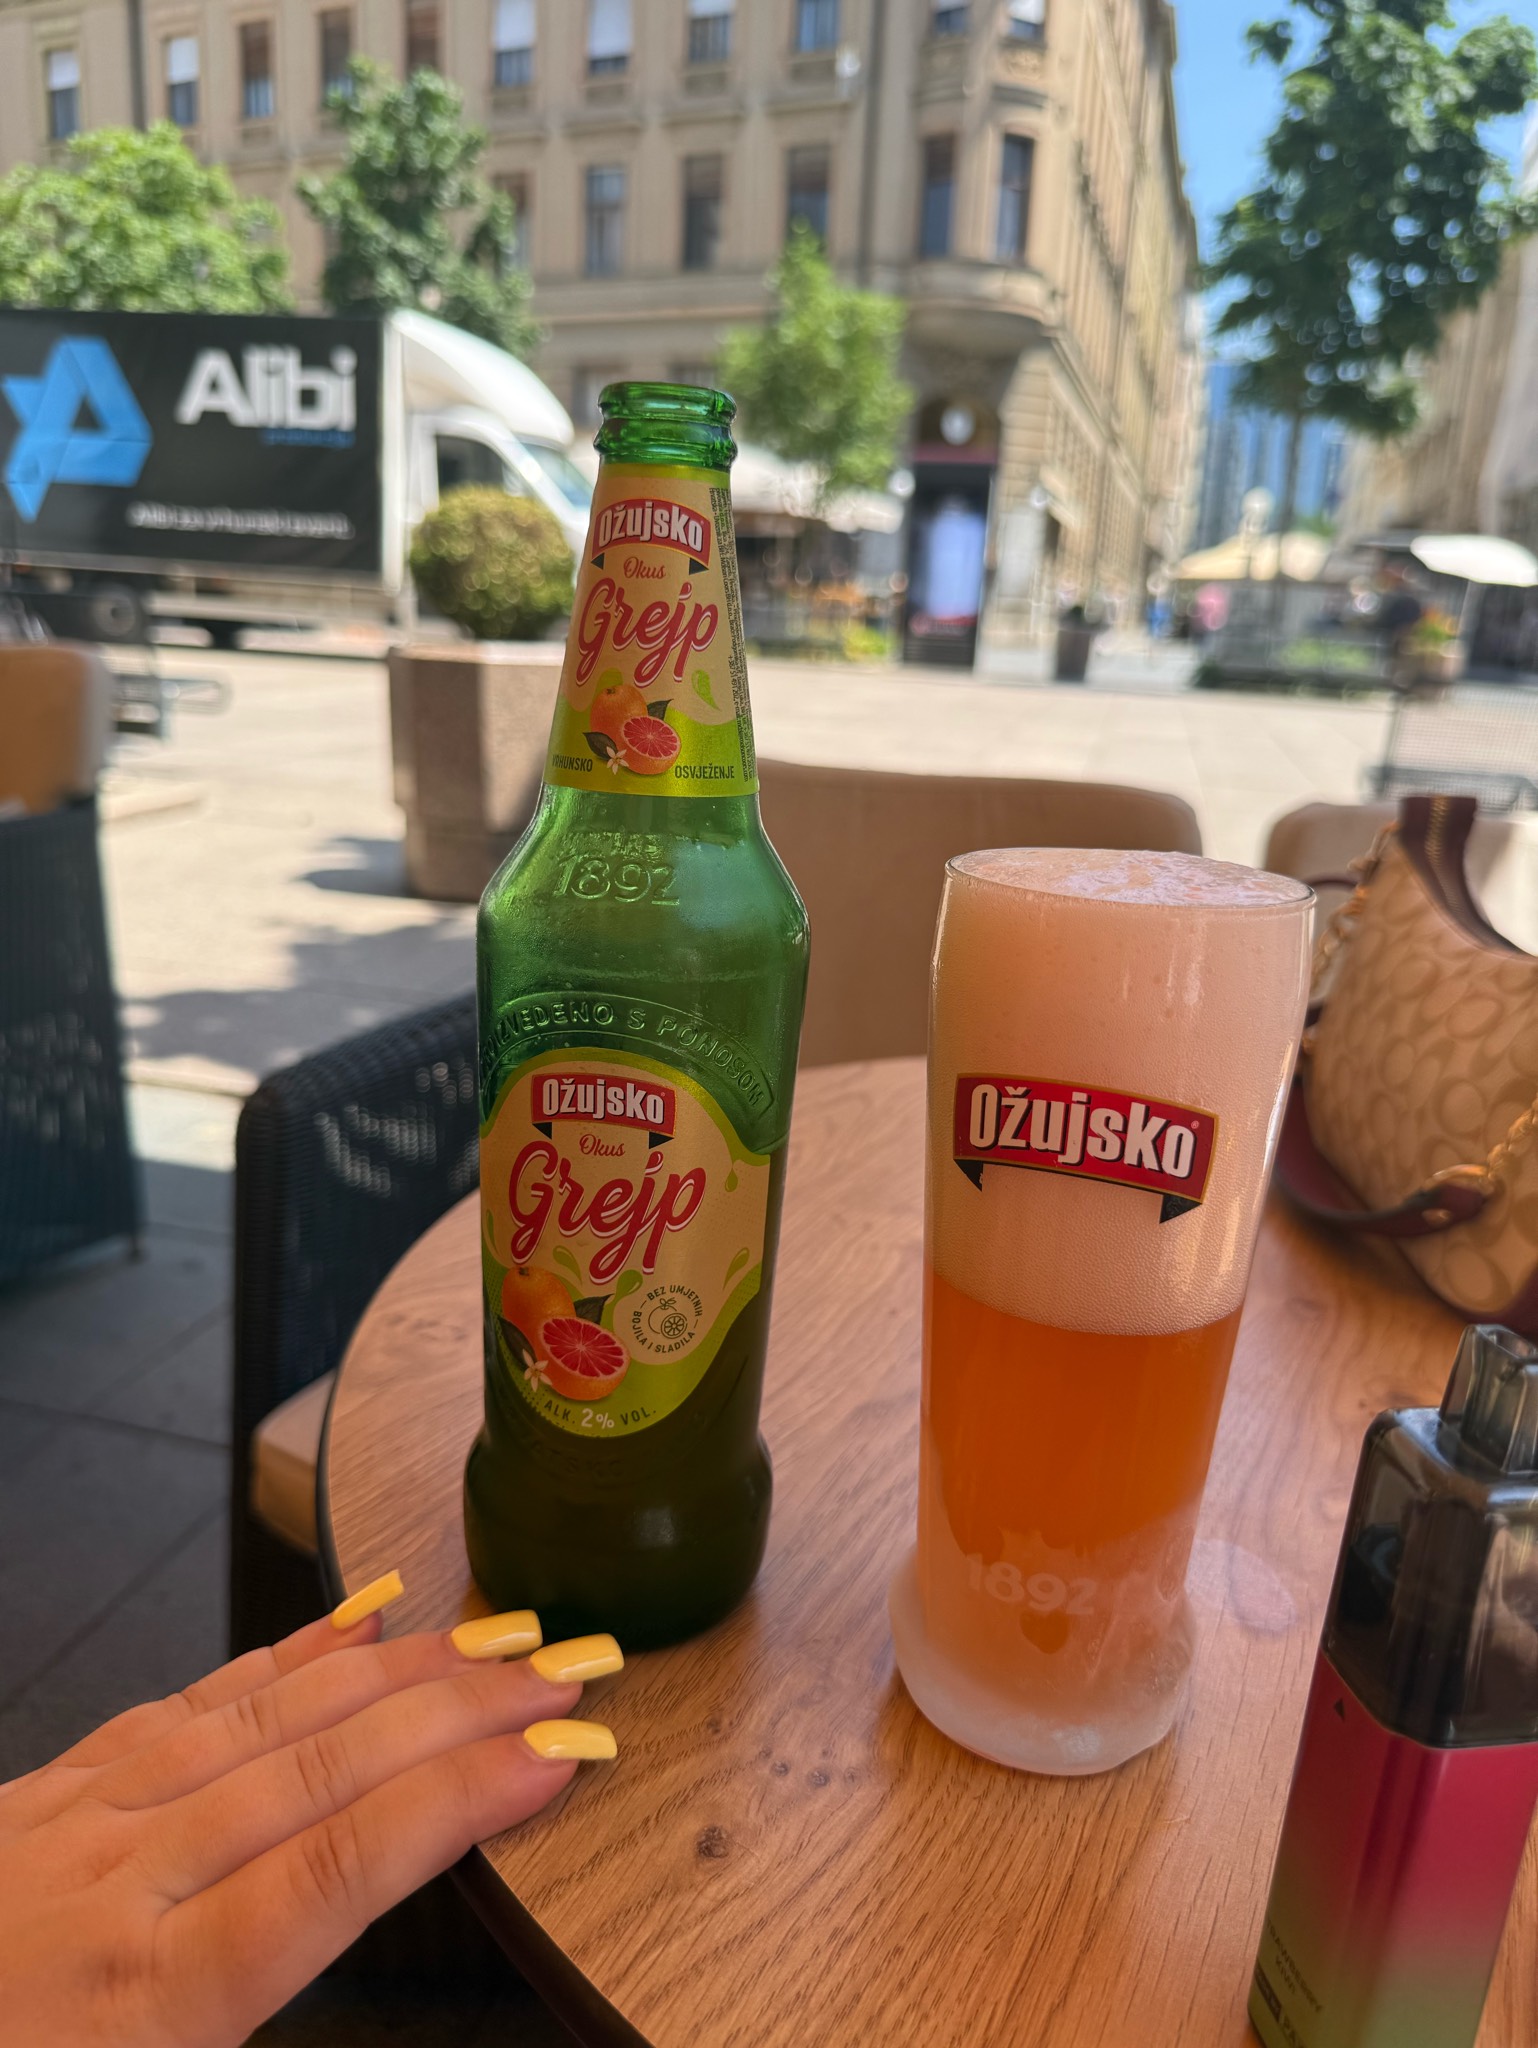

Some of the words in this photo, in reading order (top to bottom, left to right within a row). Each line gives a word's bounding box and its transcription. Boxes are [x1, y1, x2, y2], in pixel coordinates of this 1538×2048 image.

[176, 344, 357, 431] Alibi
[598, 501, 704, 553] Ožujsko
[623, 557, 667, 580] Okus
[576, 577, 719, 688] Grejp
[552, 754, 593, 773] VRHUNSKO
[675, 763, 735, 779] OSVJEŽENJE
[553, 854, 680, 906] 1892
[627, 1009, 646, 1030] S
[656, 1016, 766, 1106] PONOSOM
[542, 1077, 665, 1125] Ožujsko
[579, 1134, 625, 1157] Okus
[968, 1083, 1195, 1180] Ožujsko
[508, 1140, 707, 1284] Grejp
[646, 1286, 667, 1301] BEZ
[669, 1284, 704, 1317] UMJETNIH
[631, 1310, 648, 1346] BOJILA
[647, 1342, 654, 1350] I
[654, 1331, 696, 1354] SLADILA
[543, 1399, 576, 1424] ALK.
[581, 1407, 615, 1429] 2%
[620, 1407, 657, 1426] VOL.
[966, 1553, 1098, 1615] 1892
